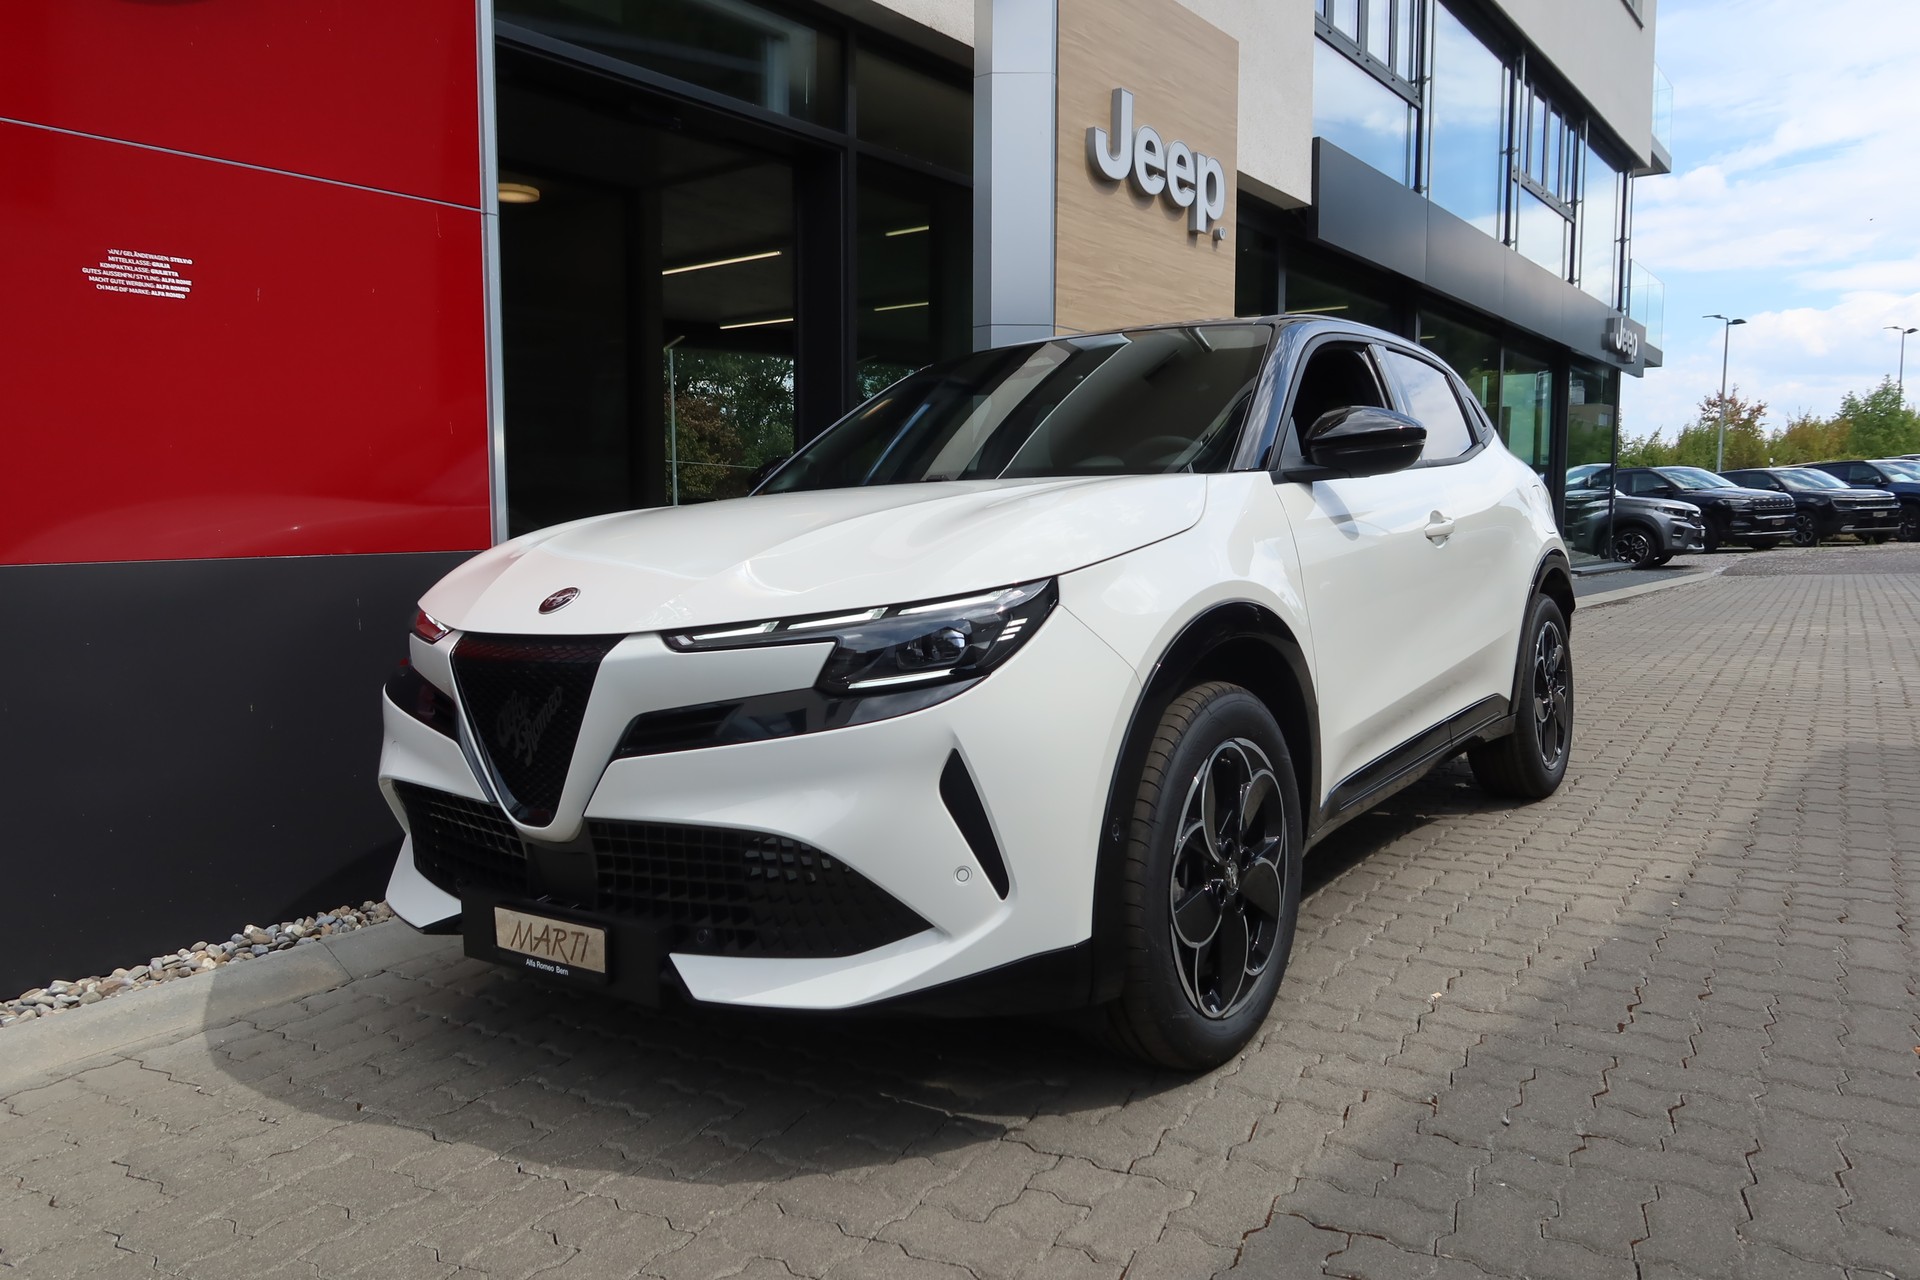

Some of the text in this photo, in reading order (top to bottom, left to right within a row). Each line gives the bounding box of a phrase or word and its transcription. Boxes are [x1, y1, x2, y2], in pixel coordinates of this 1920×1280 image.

[1086, 87, 1225, 233] Jeep
[88, 275, 109, 283] MACHT
[155, 283, 170, 291] ALFA
[170, 285, 190, 293] ROMEO
[150, 289, 165, 297] ALFA
[165, 291, 186, 299] ROMEO
[1614, 318, 1638, 363] Jeep
[510, 920, 589, 964] MARTI
[525, 958, 569, 976] Alfa Romeo Bern
